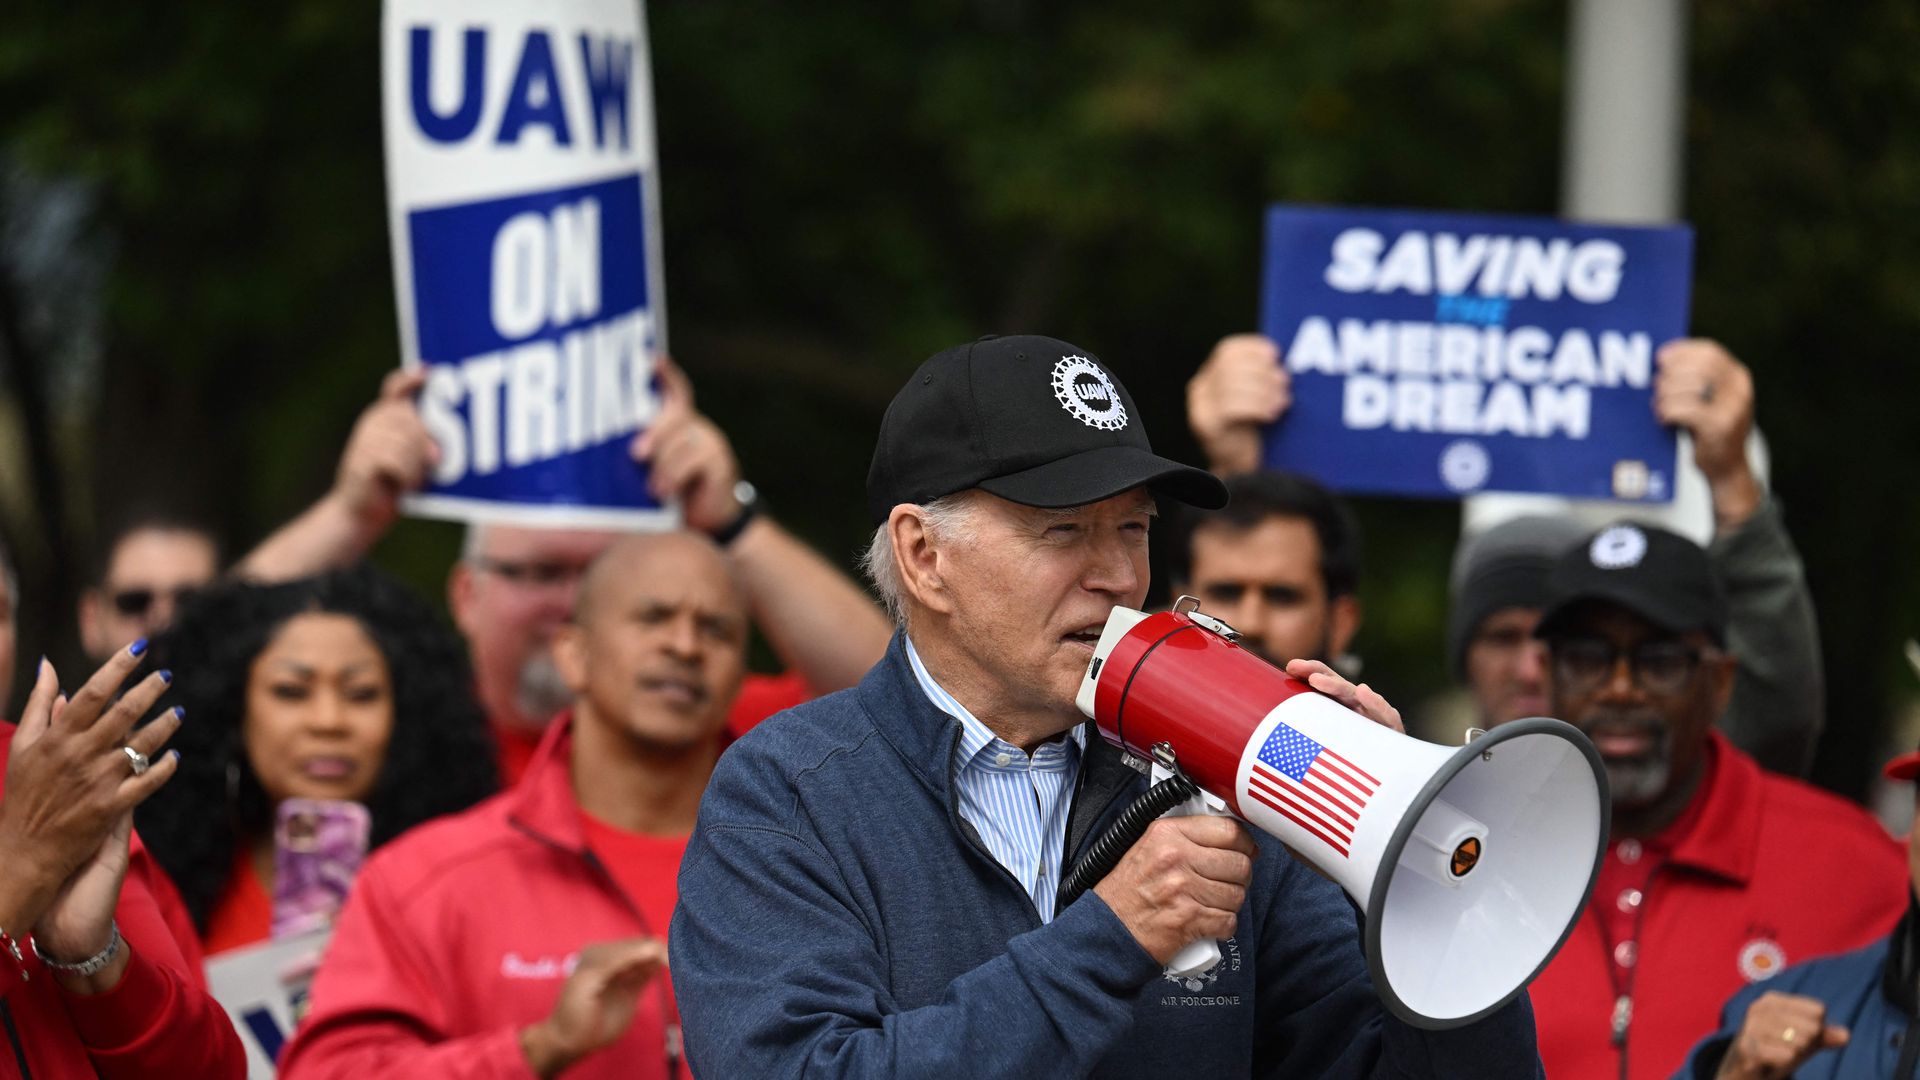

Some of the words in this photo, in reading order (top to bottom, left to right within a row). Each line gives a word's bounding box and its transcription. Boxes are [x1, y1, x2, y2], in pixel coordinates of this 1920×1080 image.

[408, 25, 633, 151] UAW
[490, 198, 602, 340] ON
[1325, 229, 1625, 303] SAVING
[1288, 317, 1652, 387] AMERICAN
[420, 307, 657, 486] STRIKE
[1074, 383, 1108, 400] UAW
[1342, 376, 1592, 440] DREAM
[1227, 936, 1241, 971] TATES
[1161, 996, 1178, 1006] AIR
[1181, 996, 1215, 1006] FORCE
[1216, 996, 1240, 1005] ONE
